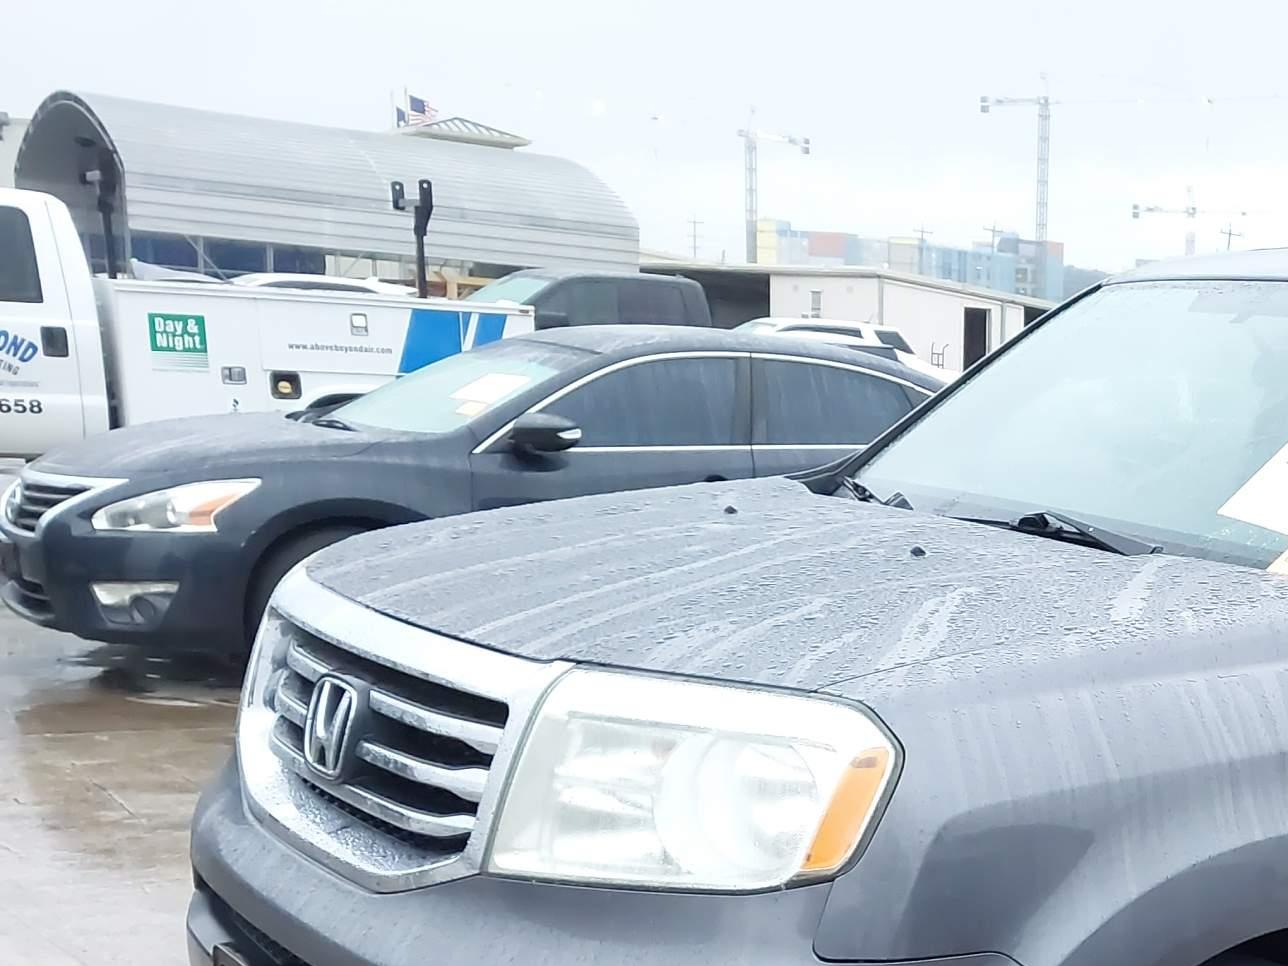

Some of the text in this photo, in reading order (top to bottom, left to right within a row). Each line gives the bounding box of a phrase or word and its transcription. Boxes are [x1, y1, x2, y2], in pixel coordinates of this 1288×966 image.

[154, 317, 198, 335] Day &
[156, 333, 201, 351] Night
